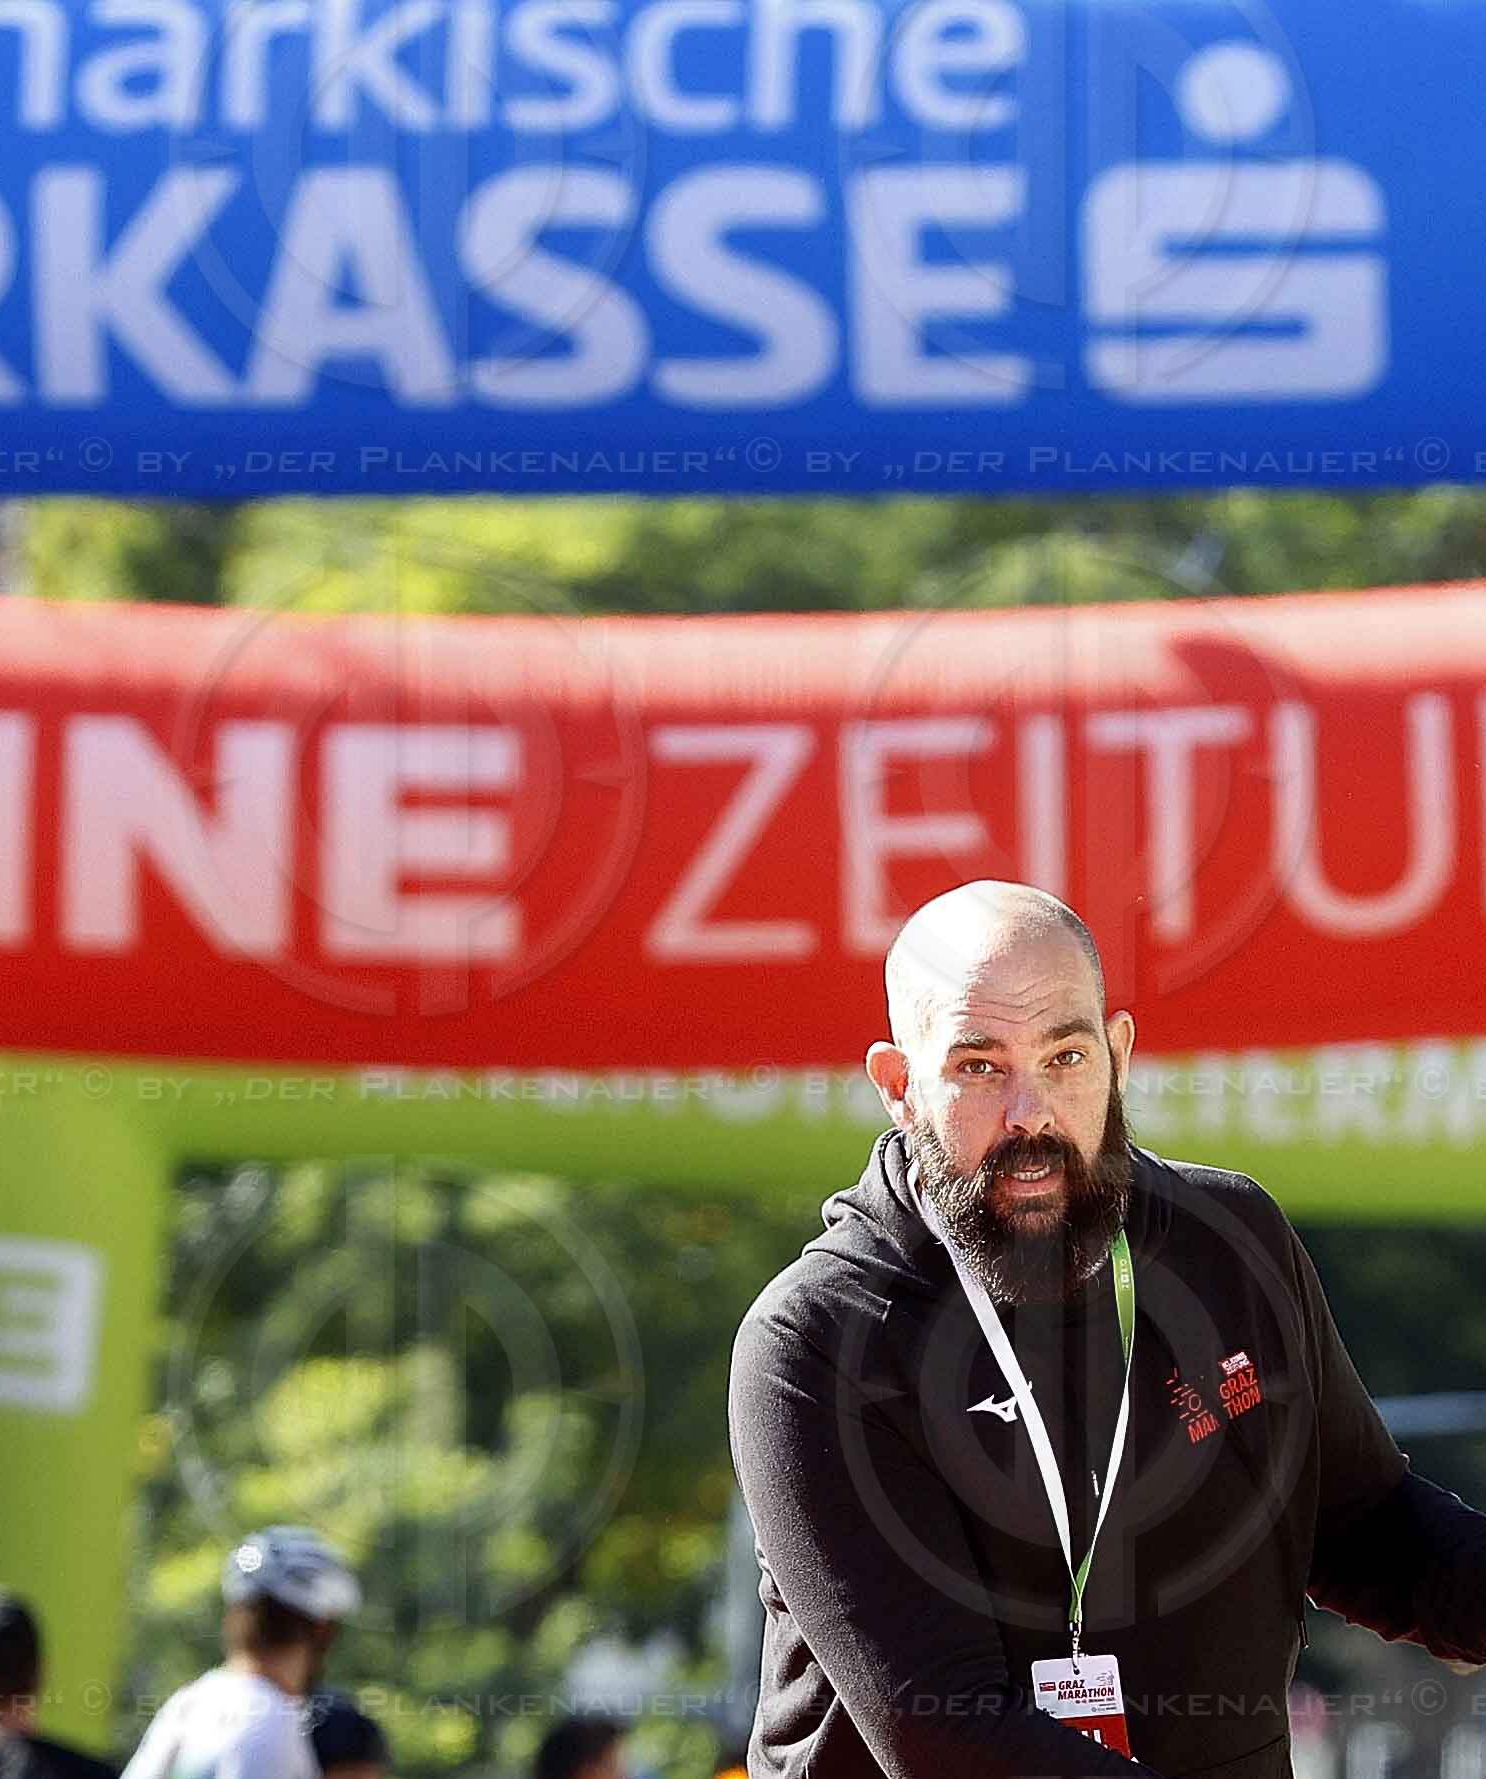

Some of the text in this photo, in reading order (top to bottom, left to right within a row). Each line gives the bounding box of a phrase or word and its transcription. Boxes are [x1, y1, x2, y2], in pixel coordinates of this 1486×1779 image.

[1219, 1367, 1258, 1400] GRAZ
[1058, 1679, 1085, 1691] GRAZ
[1057, 1686, 1115, 1701] MARATHON
